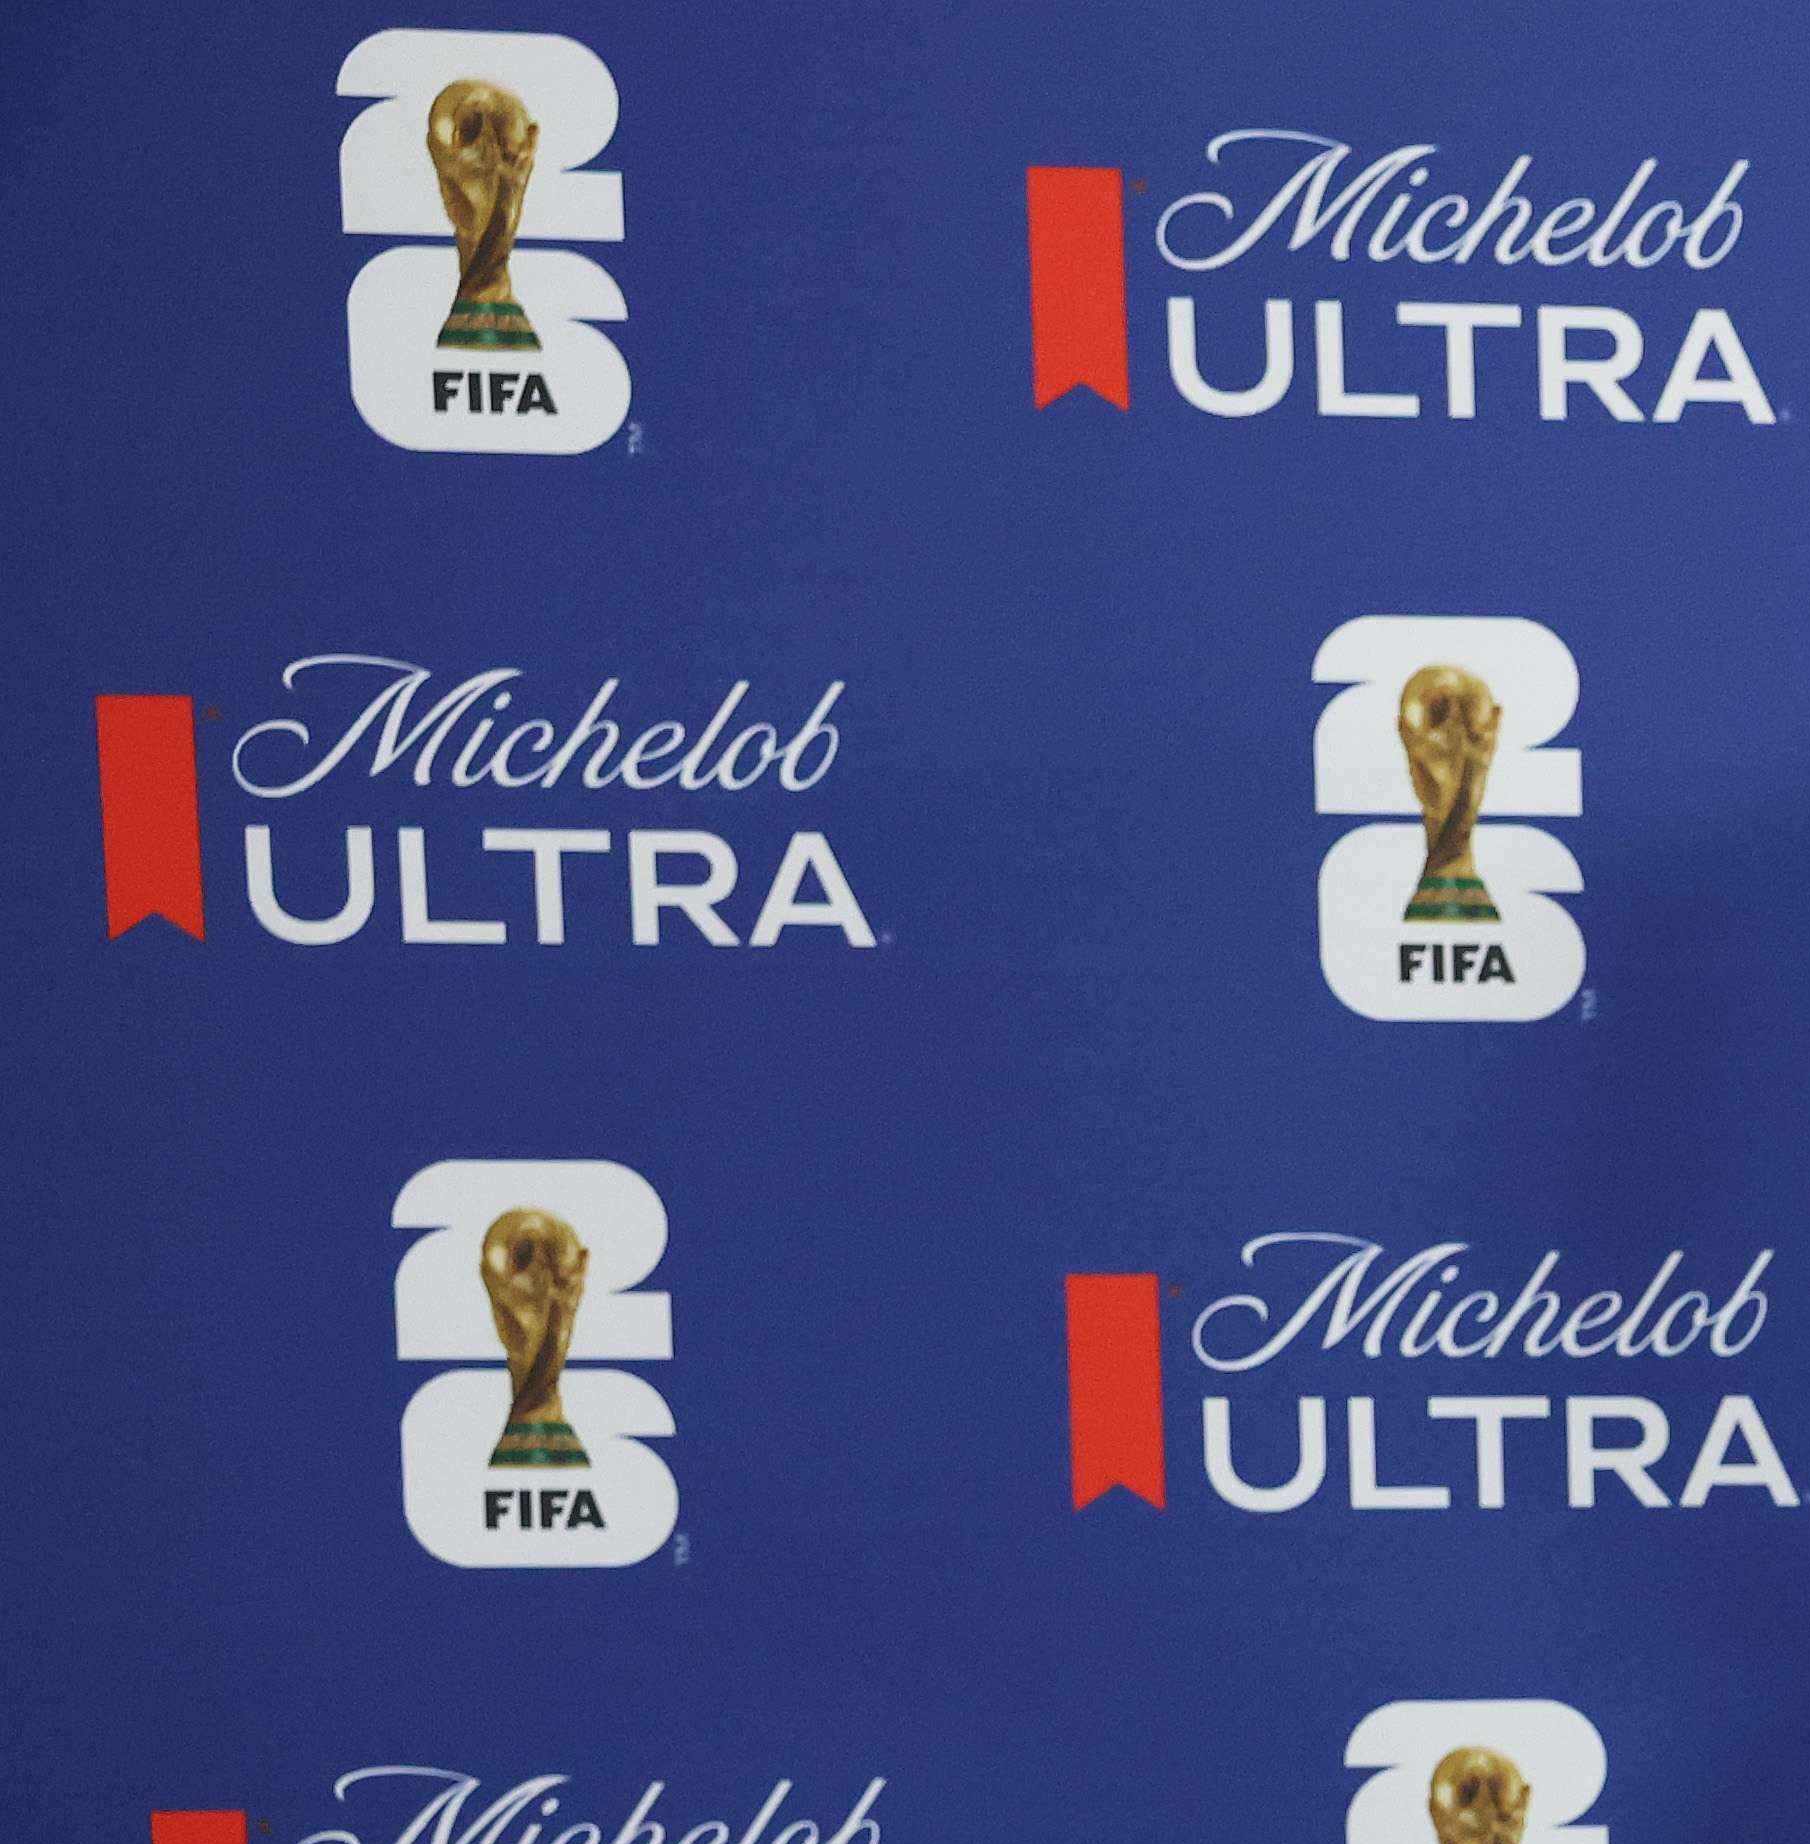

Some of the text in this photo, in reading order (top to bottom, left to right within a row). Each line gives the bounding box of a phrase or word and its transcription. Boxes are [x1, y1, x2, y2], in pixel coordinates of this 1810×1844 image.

[1157, 130, 1748, 270] Michelob
[433, 371, 557, 414] FIFA
[1168, 298, 1775, 424] ULTRA
[233, 655, 844, 797] Michelob
[245, 826, 876, 947] ULTRA
[1400, 944, 1515, 983] FIFA
[1193, 1233, 1772, 1371] Michelob
[485, 1490, 605, 1529] FIFA
[1203, 1396, 1799, 1512] ULTRA
